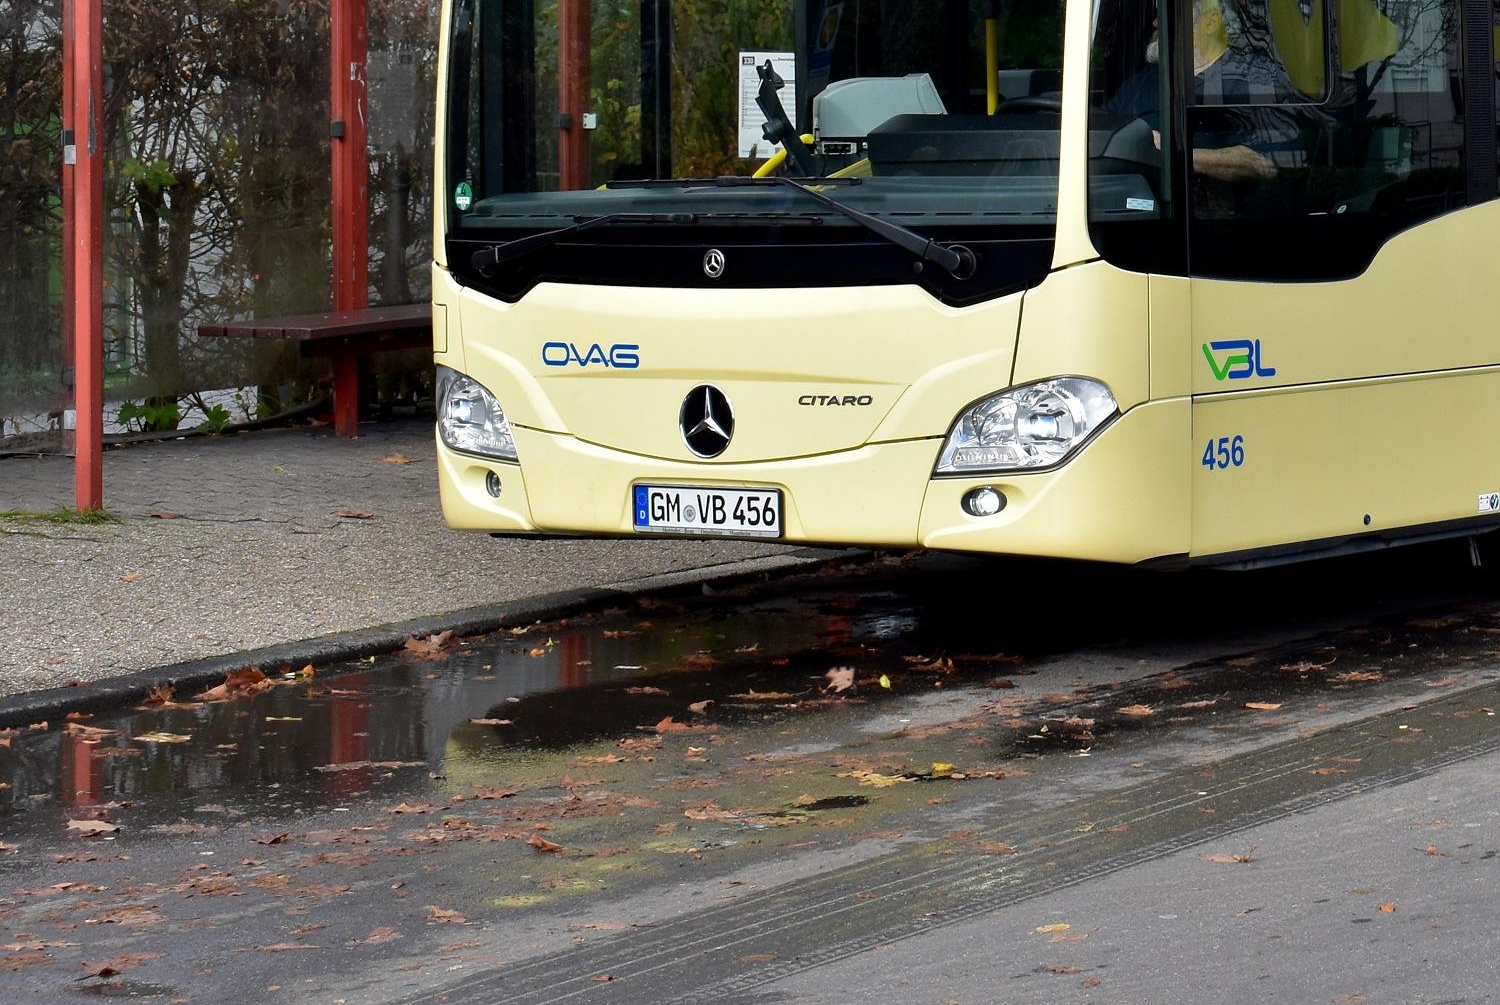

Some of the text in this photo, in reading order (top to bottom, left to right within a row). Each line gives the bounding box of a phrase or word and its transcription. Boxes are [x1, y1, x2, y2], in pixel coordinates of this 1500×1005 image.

[543, 341, 640, 369] OVAG
[798, 395, 873, 407] CITARO
[1201, 435, 1245, 471] 456
[640, 492, 776, 526] D GM VB 456
